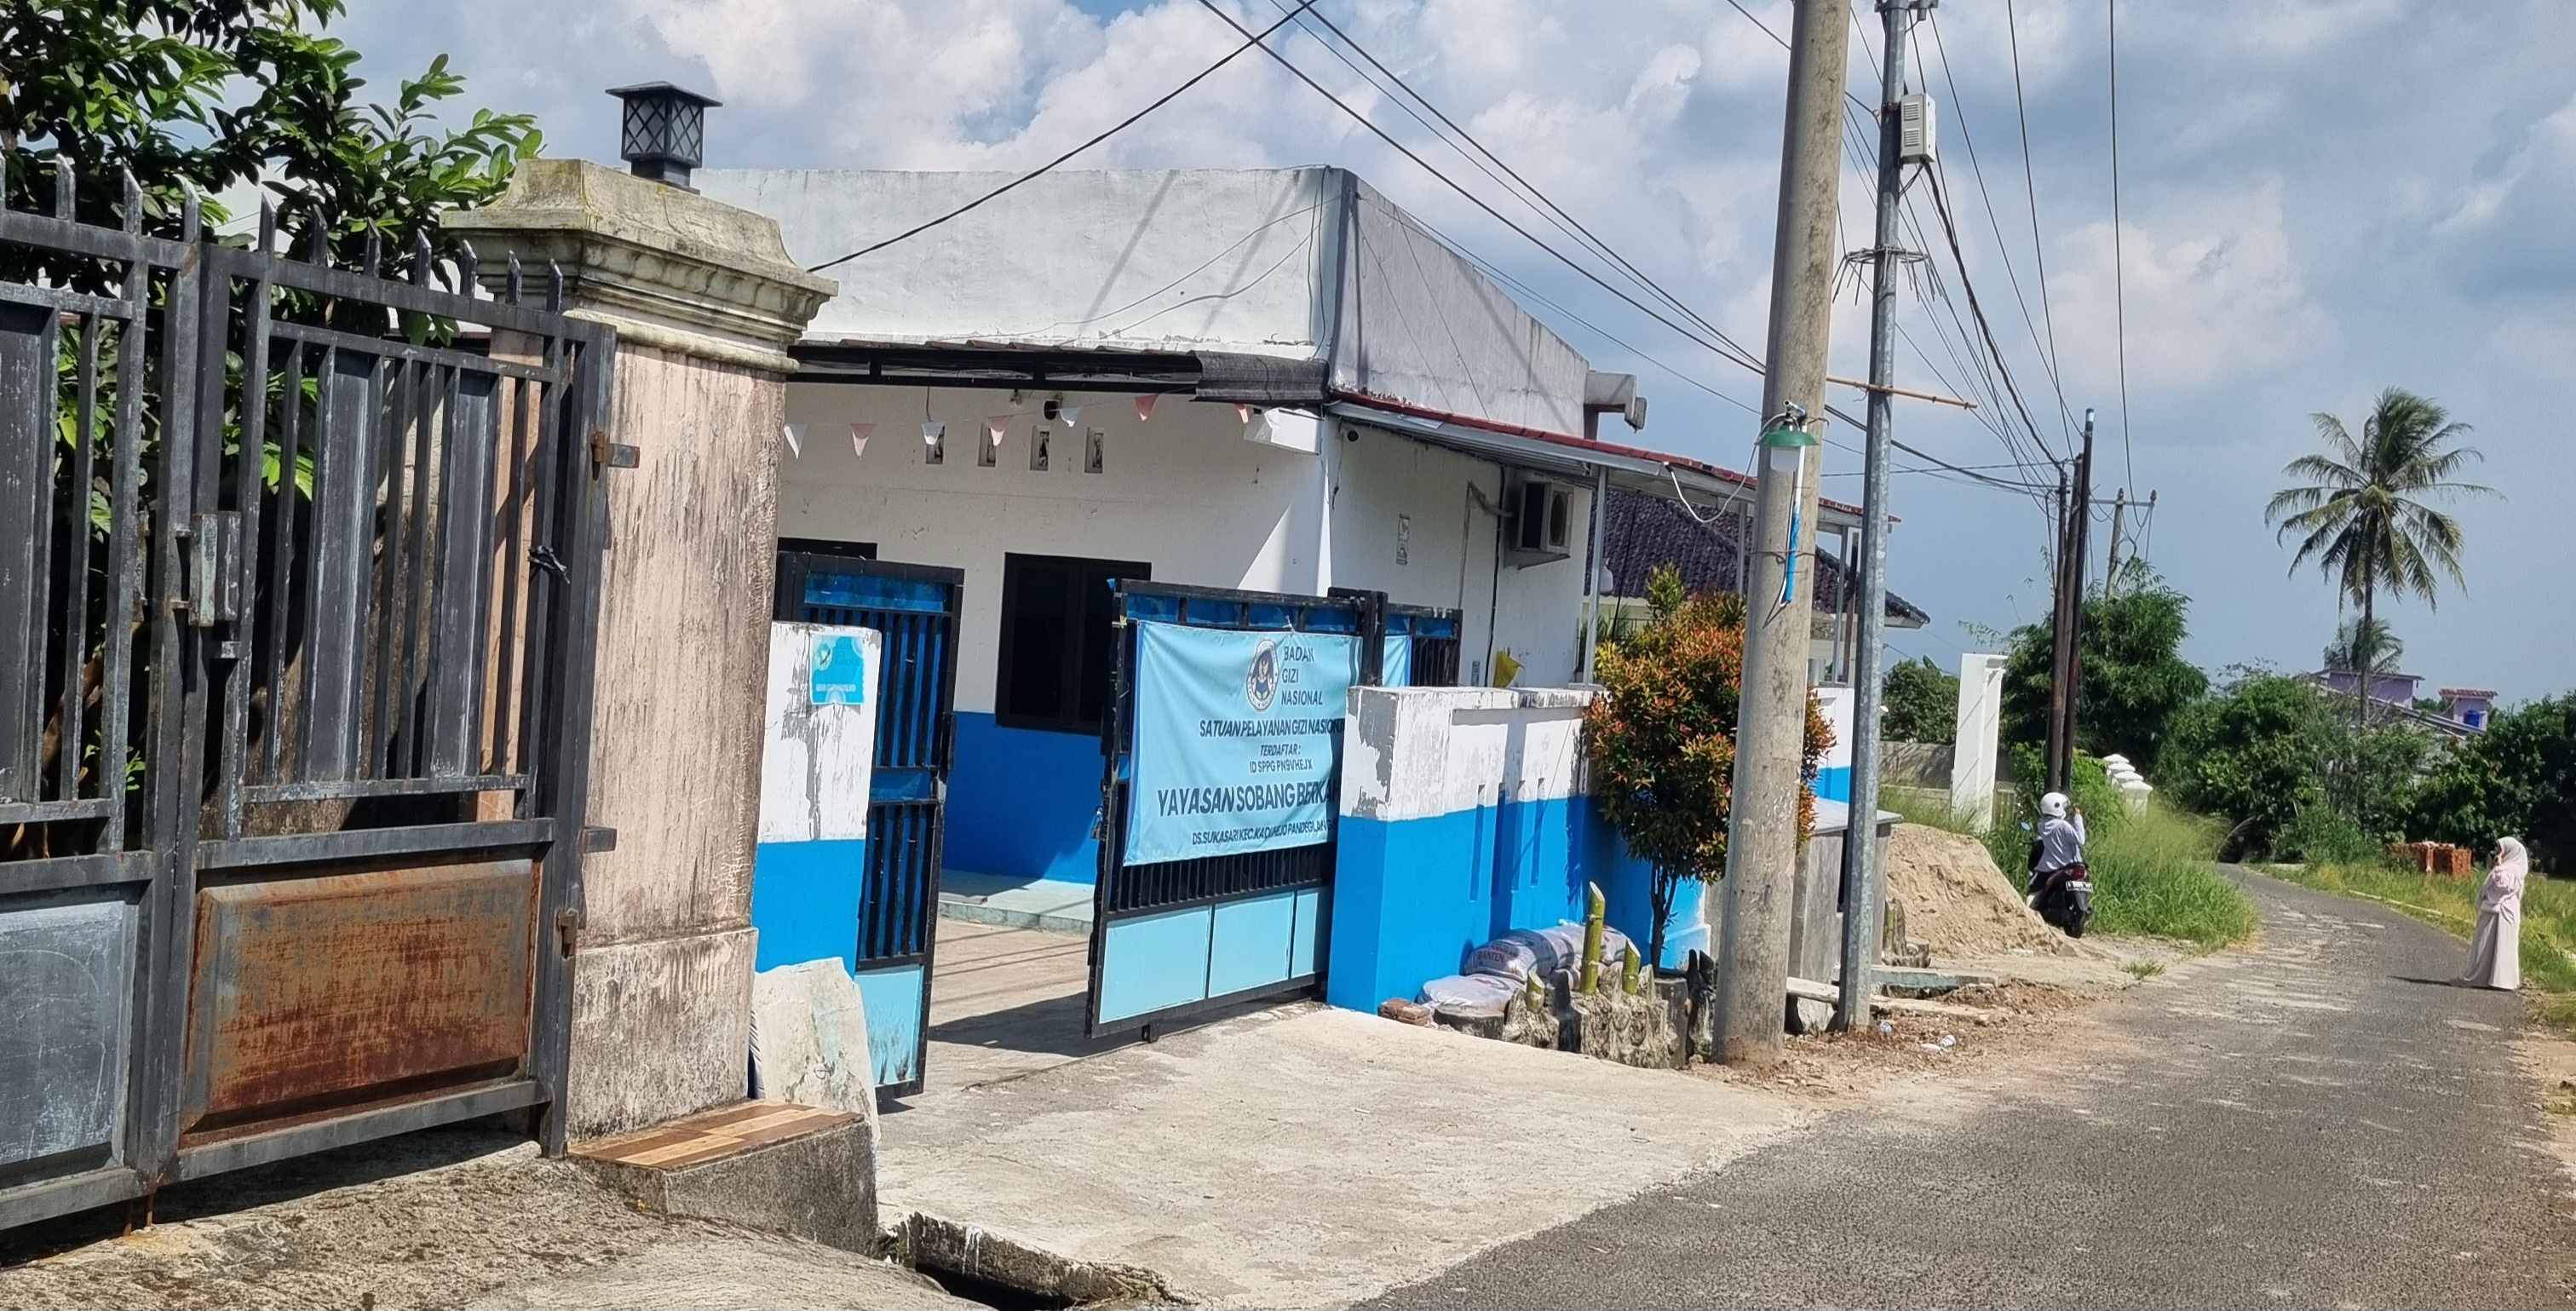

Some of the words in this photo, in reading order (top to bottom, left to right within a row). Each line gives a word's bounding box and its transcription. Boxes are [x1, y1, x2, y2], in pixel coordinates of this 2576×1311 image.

[1284, 647, 1314, 662] BADAN
[1282, 669, 1298, 683] GIZI
[1281, 690, 1323, 705] NASIONAL
[1199, 720, 1241, 737] SATUAN
[1240, 719, 1291, 737] PELAYANAN
[1291, 719, 1308, 735] GIZI
[1250, 761, 1256, 773] ID
[1257, 760, 1276, 773] SPPG
[1158, 786, 1234, 817] YAYASAN
[1236, 782, 1296, 811] SOBANG
